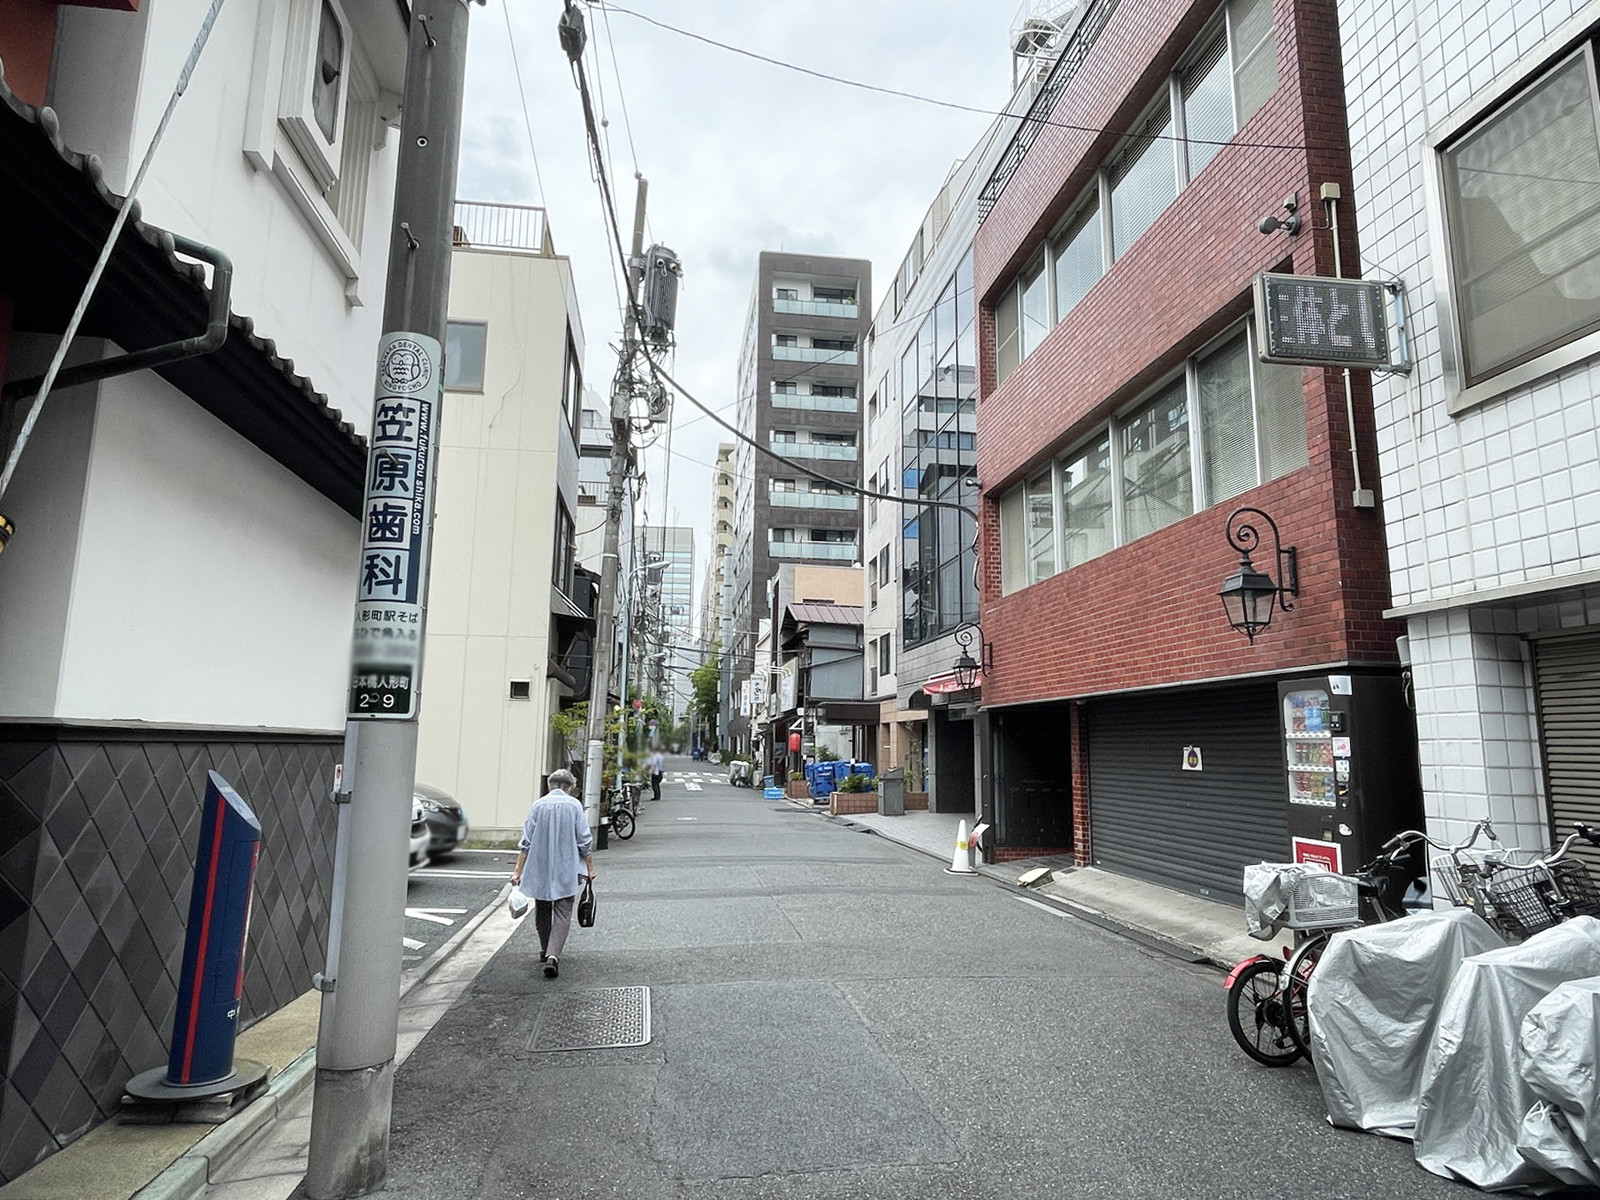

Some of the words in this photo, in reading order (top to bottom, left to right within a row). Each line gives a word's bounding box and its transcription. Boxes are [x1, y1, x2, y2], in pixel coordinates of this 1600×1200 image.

[397, 341, 423, 358] DENTAL
[421, 358, 430, 380] CLINIC
[363, 403, 416, 595] 笠原歯科
